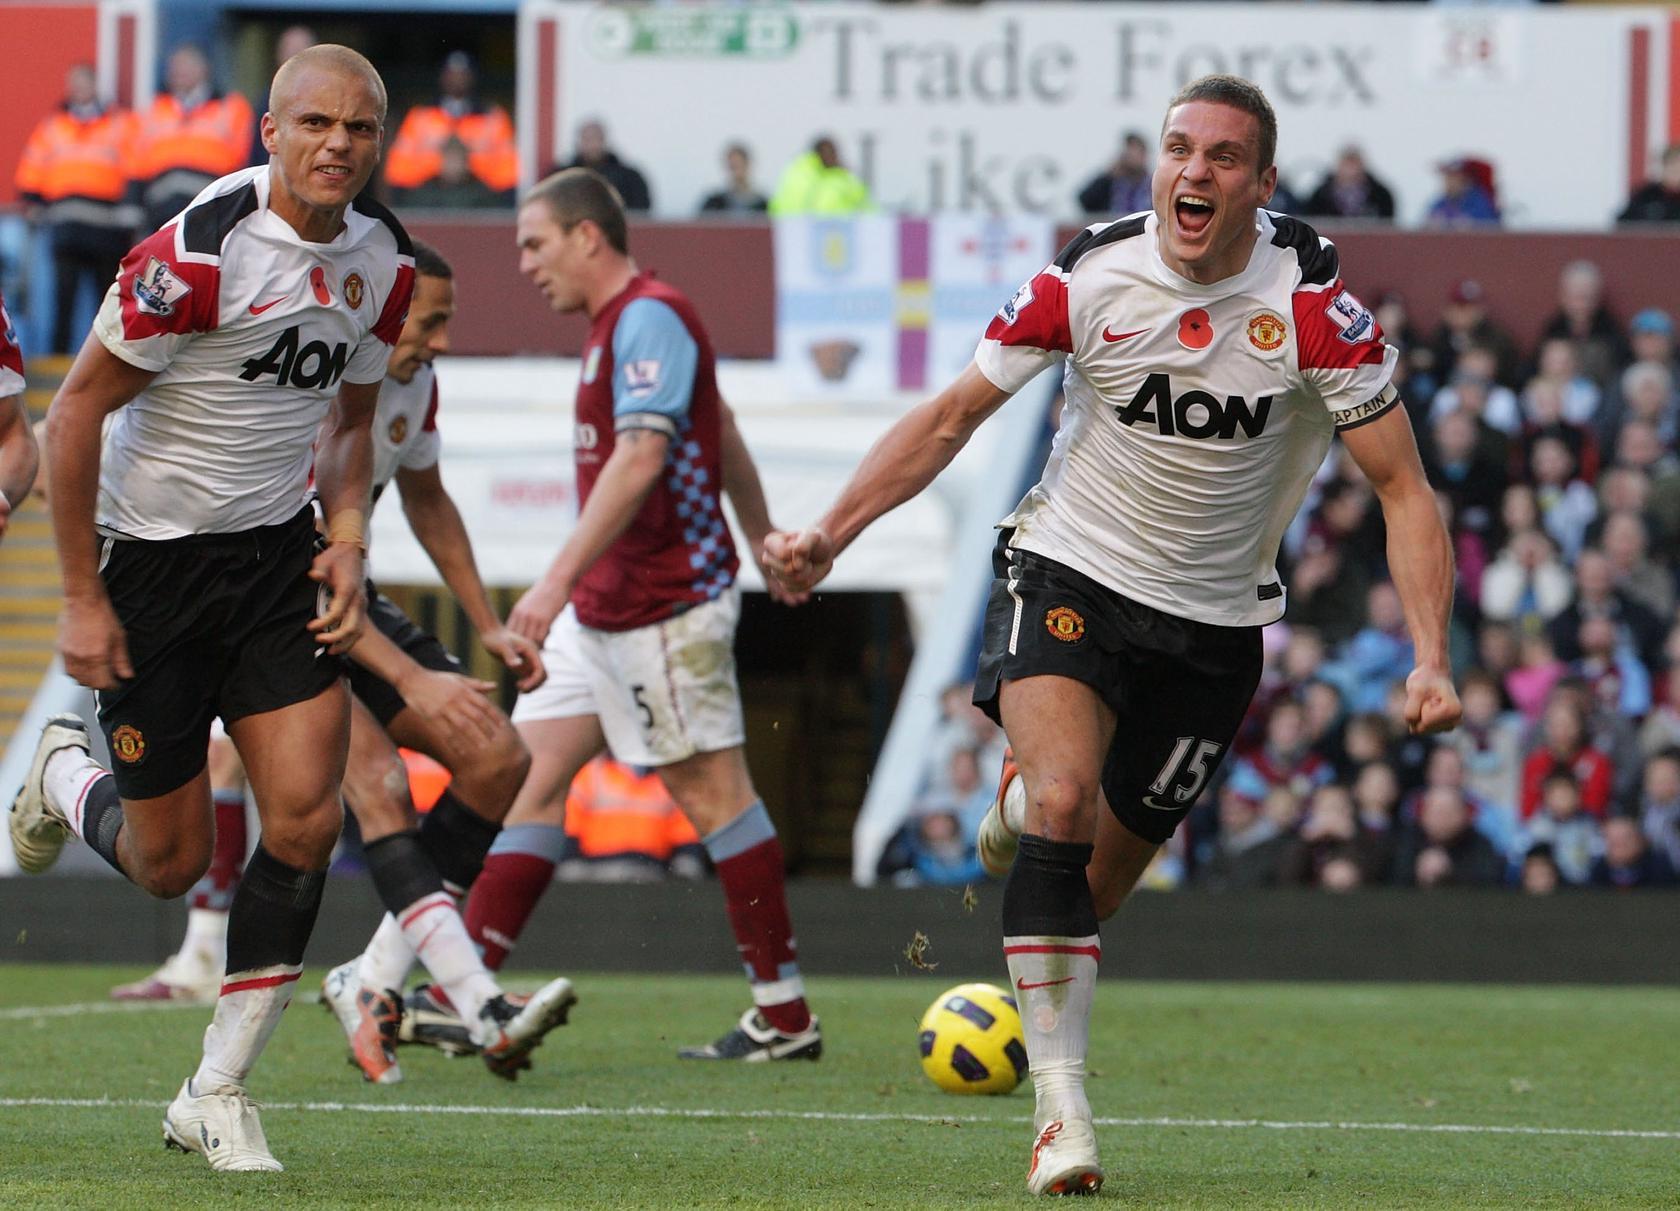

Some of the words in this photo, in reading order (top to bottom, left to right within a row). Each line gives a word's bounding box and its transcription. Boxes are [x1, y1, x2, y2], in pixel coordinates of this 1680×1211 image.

[812, 17, 1076, 104] Trade
[1117, 19, 1377, 105] Forex
[854, 129, 1065, 213] Like
[1334, 394, 1387, 424] APTAIN
[630, 684, 655, 730] 5
[1147, 736, 1223, 803] 15
